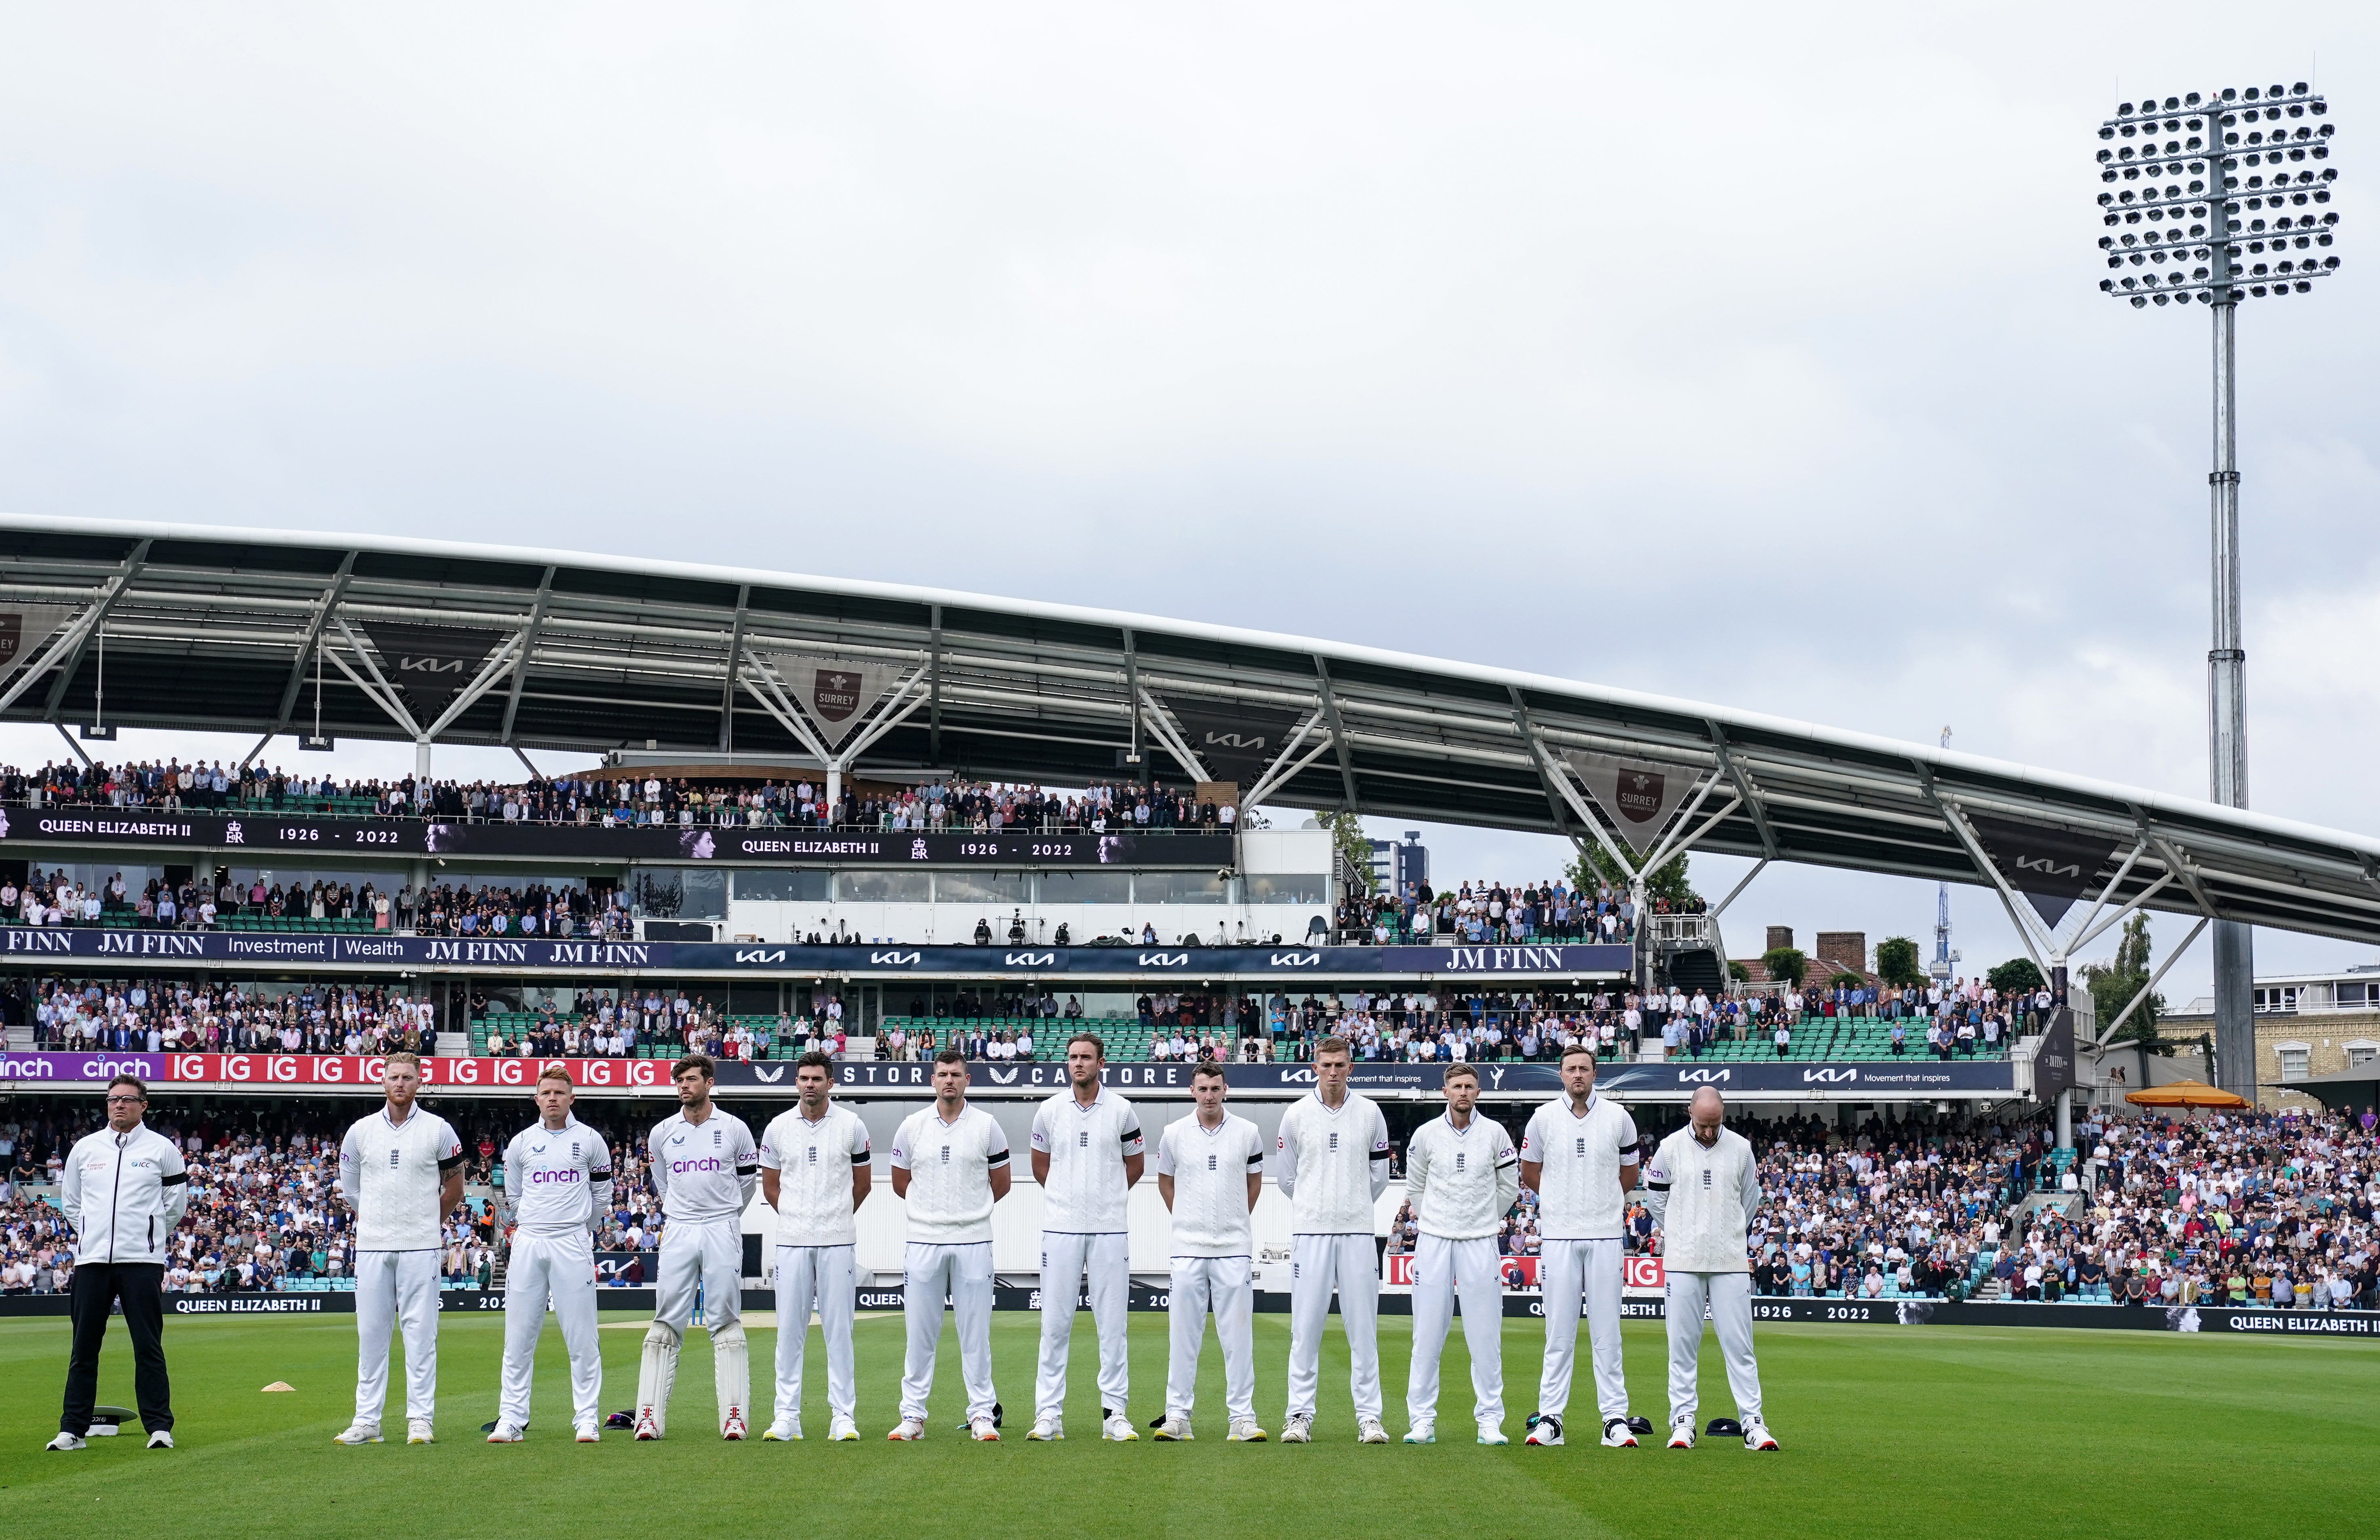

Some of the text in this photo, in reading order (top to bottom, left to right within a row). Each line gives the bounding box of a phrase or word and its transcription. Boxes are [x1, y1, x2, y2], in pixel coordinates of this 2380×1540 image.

[819, 693, 854, 705] SURREY
[1621, 793, 1657, 807] SURREY
[40, 820, 190, 836] QUEEN ELIZABETH II
[281, 829, 318, 840] 1926
[357, 831, 397, 843] 2022
[742, 841, 878, 853] QUEEN ELIZABETH II
[962, 844, 997, 854] 1926
[1033, 845, 1071, 855] 2022
[7, 932, 72, 951] FINN
[98, 933, 205, 954] JM FINN
[229, 937, 403, 956] Investment Wealth
[426, 942, 527, 962] JM FINN
[550, 944, 650, 964] JM FINN
[1446, 948, 1563, 969] JM FINN
[0, 1053, 53, 1077] inch
[83, 1054, 151, 1078] cinch
[174, 1055, 204, 1080] IG
[220, 1055, 250, 1080] IG
[267, 1056, 297, 1081] IG
[313, 1057, 342, 1082] IG
[359, 1058, 385, 1083] IG
[420, 1059, 433, 1083] G
[449, 1059, 478, 1083] IG
[494, 1060, 522, 1084] IG
[582, 1060, 611, 1085] IG
[627, 1061, 654, 1085] IG
[844, 1067, 922, 1083] STOR
[1032, 1068, 1177, 1084] CATORE
[1395, 1075, 1422, 1084] inspires
[1922, 1074, 1950, 1083] inspires
[1277, 1137, 1283, 1148] G
[1521, 1138, 1528, 1149] G
[591, 1163, 611, 1173] cinc
[673, 1155, 719, 1173] cinch
[533, 1165, 579, 1183] cinch
[1648, 1169, 1663, 1178] nch
[1627, 1259, 1658, 1285] IG
[176, 1300, 320, 1313] QUEEN ELIZABETH II
[859, 1294, 903, 1306] QUEEN
[1150, 1296, 1169, 1306] 20
[1754, 1306, 1791, 1318] 1926
[1828, 1308, 1869, 1319] 2022
[2230, 1317, 2283, 1330] QUEEN
[2288, 1318, 2367, 1331] ELIZABETH
